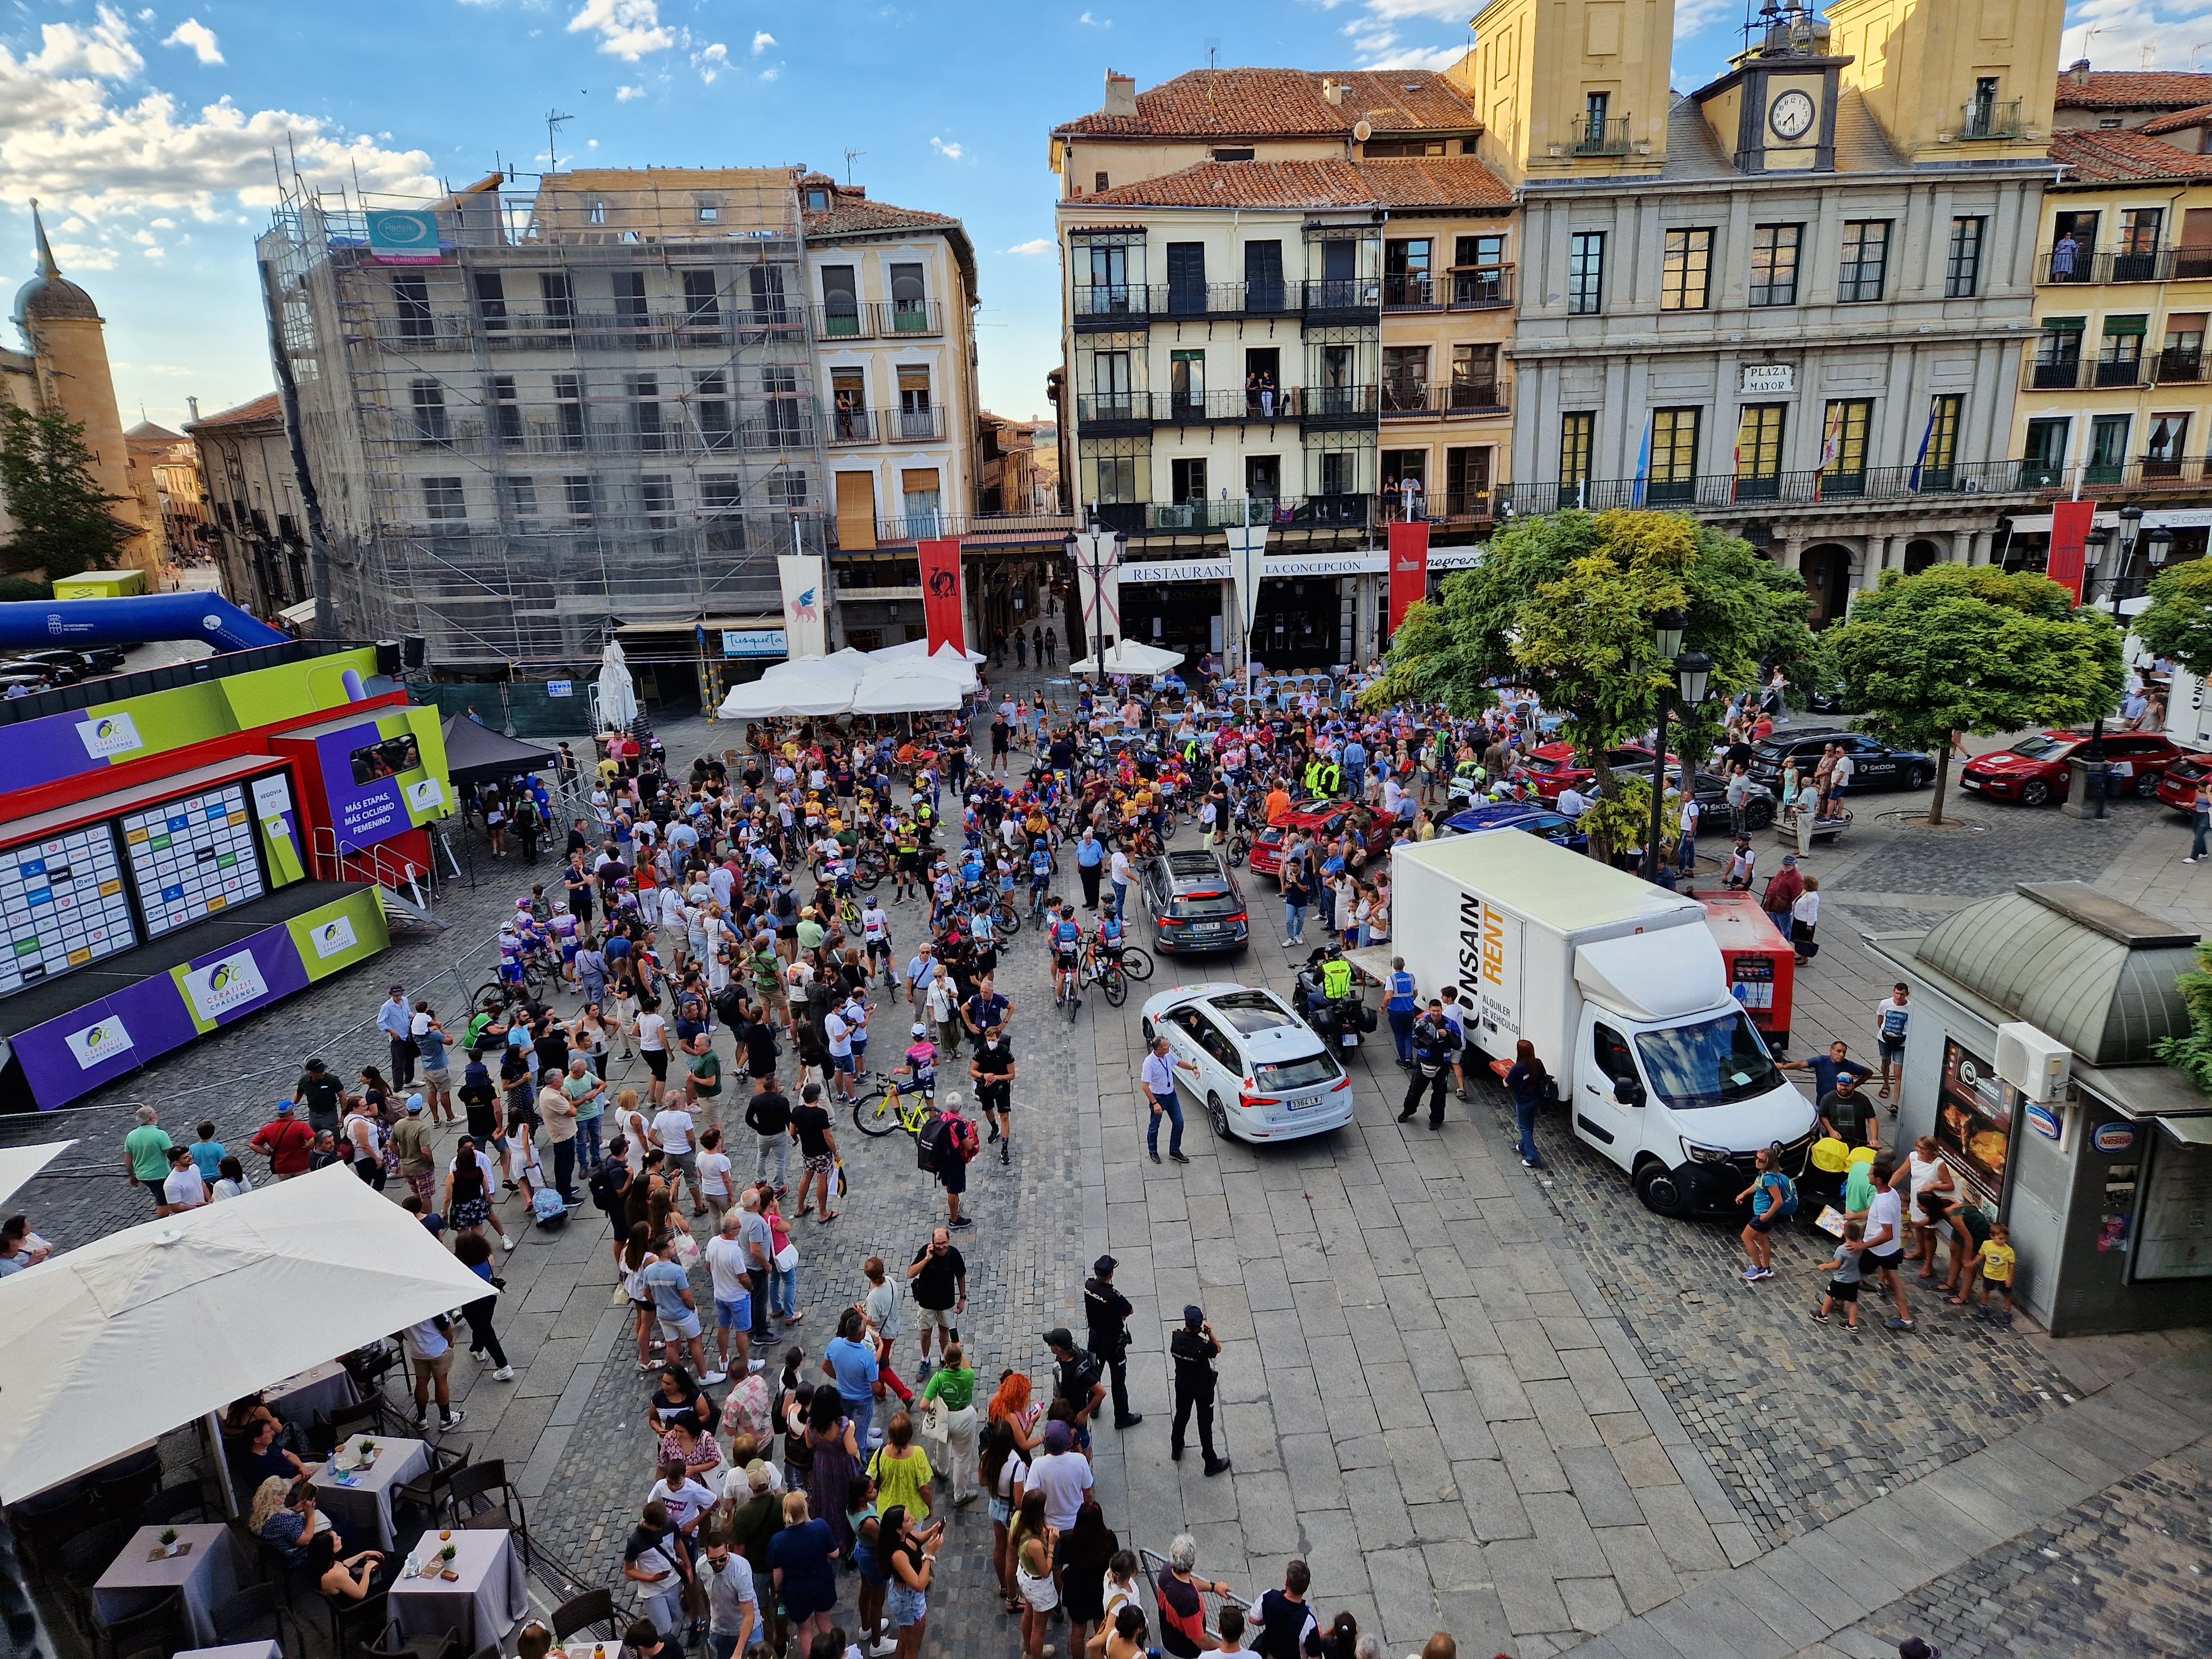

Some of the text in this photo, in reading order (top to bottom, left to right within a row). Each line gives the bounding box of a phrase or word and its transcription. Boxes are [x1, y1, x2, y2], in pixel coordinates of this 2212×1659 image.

[1751, 367, 1787, 377] PLAZA
[1750, 382, 1785, 390] MAYOR
[1265, 564, 1279, 573] LA
[1283, 560, 1361, 573] CONCEPCIÓN
[94, 734, 130, 747] CERATIZIT
[97, 740, 133, 752] CHALLENGE
[260, 788, 283, 800] SEGOVIA
[345, 800, 362, 814] MÁS
[345, 802, 395, 826] MÁS CICLISMO
[1709, 802, 1731, 811] ŠKOD
[353, 815, 391, 836] FEMENINO
[322, 935, 347, 948] CERATIZIT
[324, 939, 349, 952] CHALLENGE
[1483, 903, 1503, 985] RENT
[207, 979, 251, 1004] CERATIZIT
[210, 986, 255, 1010] CHALLENGE
[1483, 994, 1510, 1018] ALQUILER
[1482, 1005, 1519, 1035] DE VEHÍCULOS
[85, 1037, 120, 1057] CERATIZIT
[87, 1042, 123, 1061] CHALLENGE
[912, 1048, 932, 1056] VALCAR
[1169, 1042, 1182, 1059] KODA
[1976, 1077, 1999, 1096] muñoz
